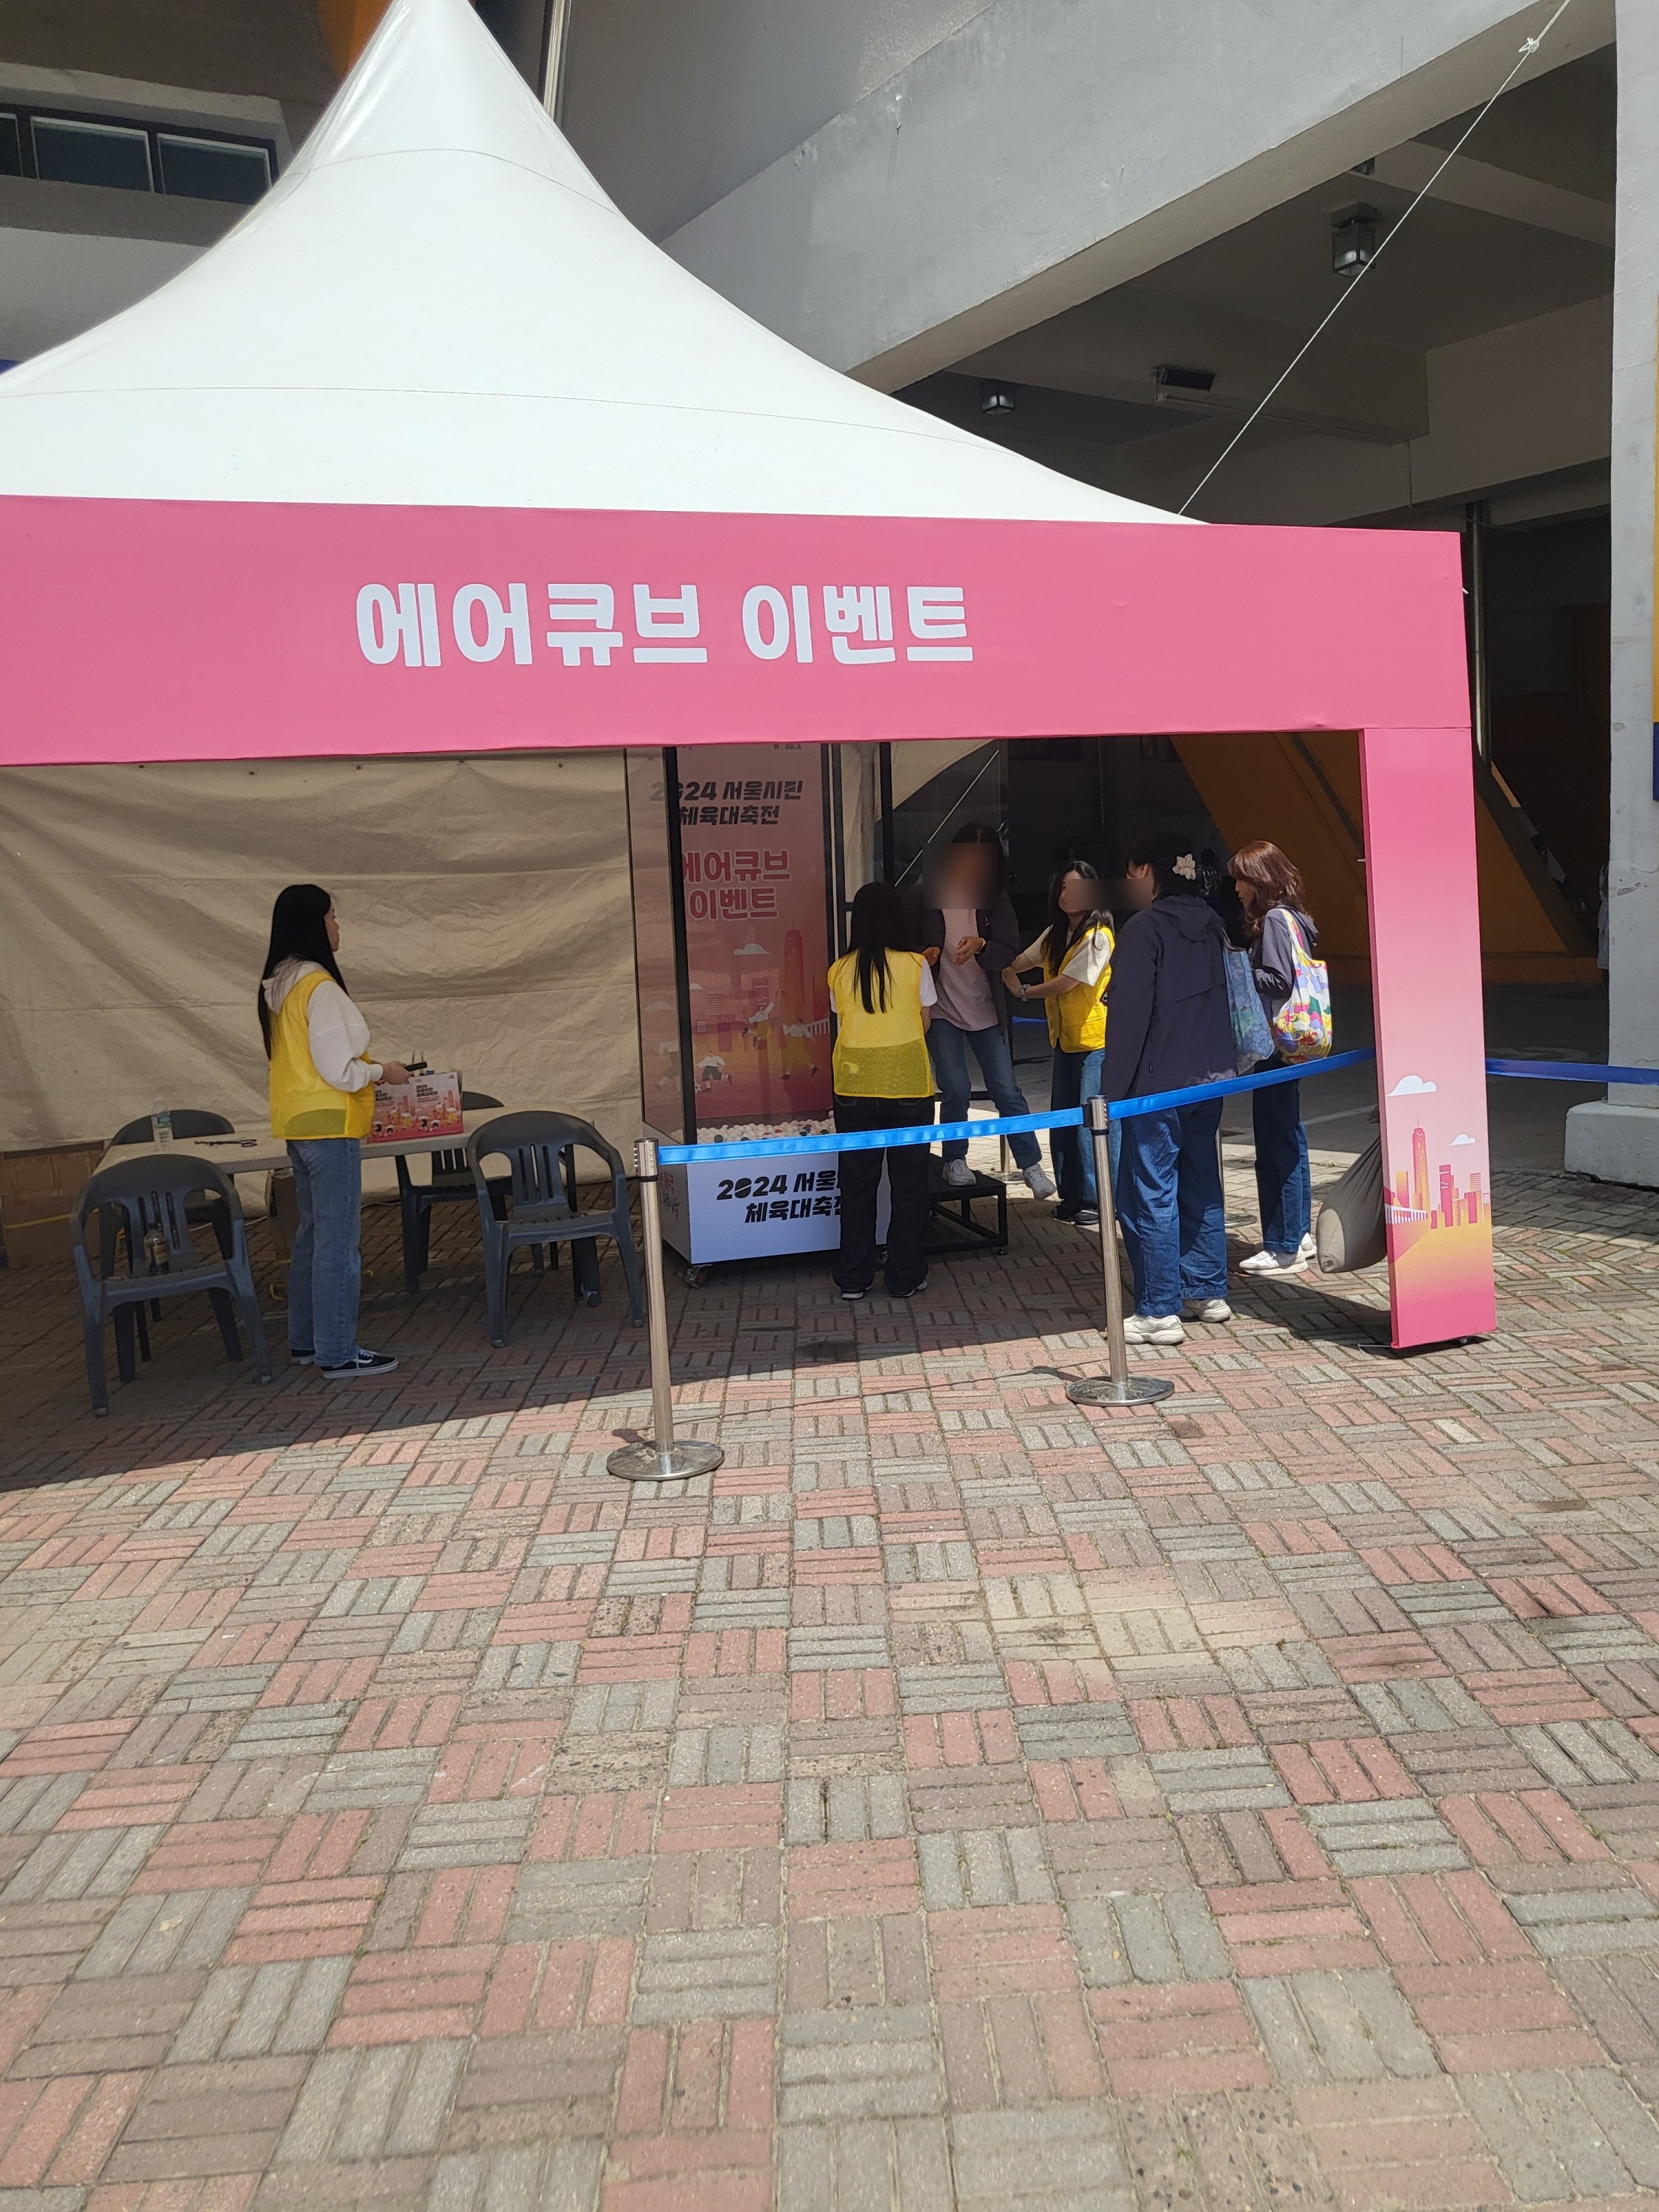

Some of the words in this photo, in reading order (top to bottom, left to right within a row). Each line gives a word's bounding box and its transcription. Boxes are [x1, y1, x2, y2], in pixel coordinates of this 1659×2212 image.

[355, 582, 708, 667] 에어큐브
[742, 585, 974, 665] 이벤트
[650, 782, 717, 801] 224
[680, 806, 779, 825] 체육대축전
[682, 850, 790, 883] 에어큐브
[689, 888, 778, 919] 이벤트
[717, 1175, 787, 1200] 2024
[793, 1169, 840, 1193] 서울
